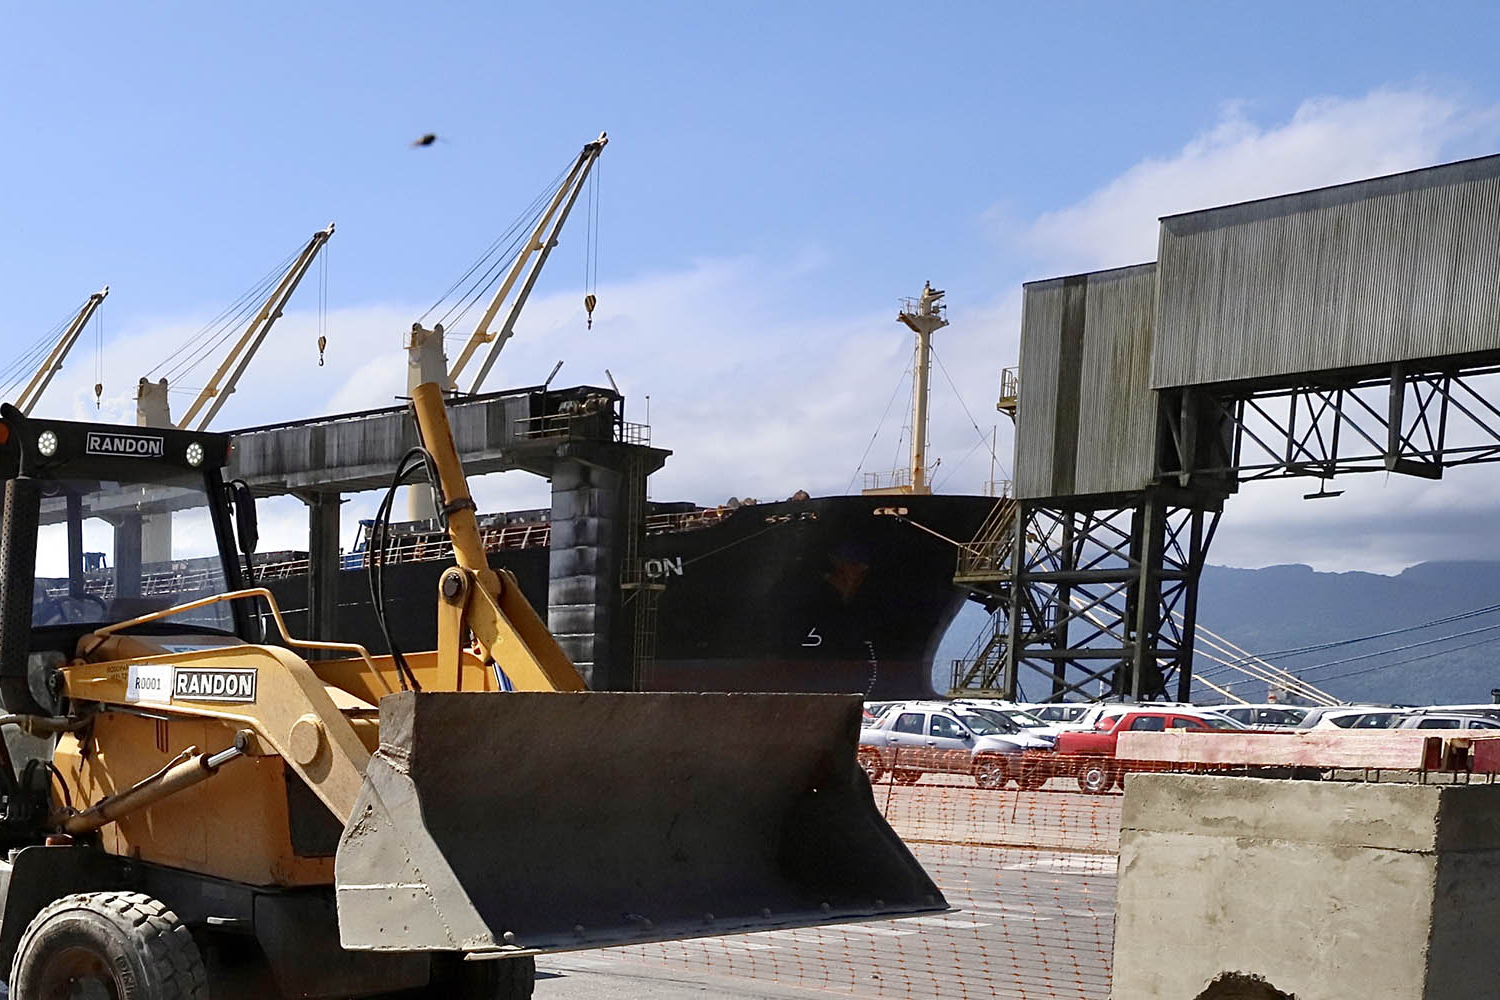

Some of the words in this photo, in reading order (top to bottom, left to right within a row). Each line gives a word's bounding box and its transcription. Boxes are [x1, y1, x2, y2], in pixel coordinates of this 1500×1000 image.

[90, 436, 160, 454] RANDON
[135, 676, 161, 691] R0001
[176, 673, 253, 696] RANDON
